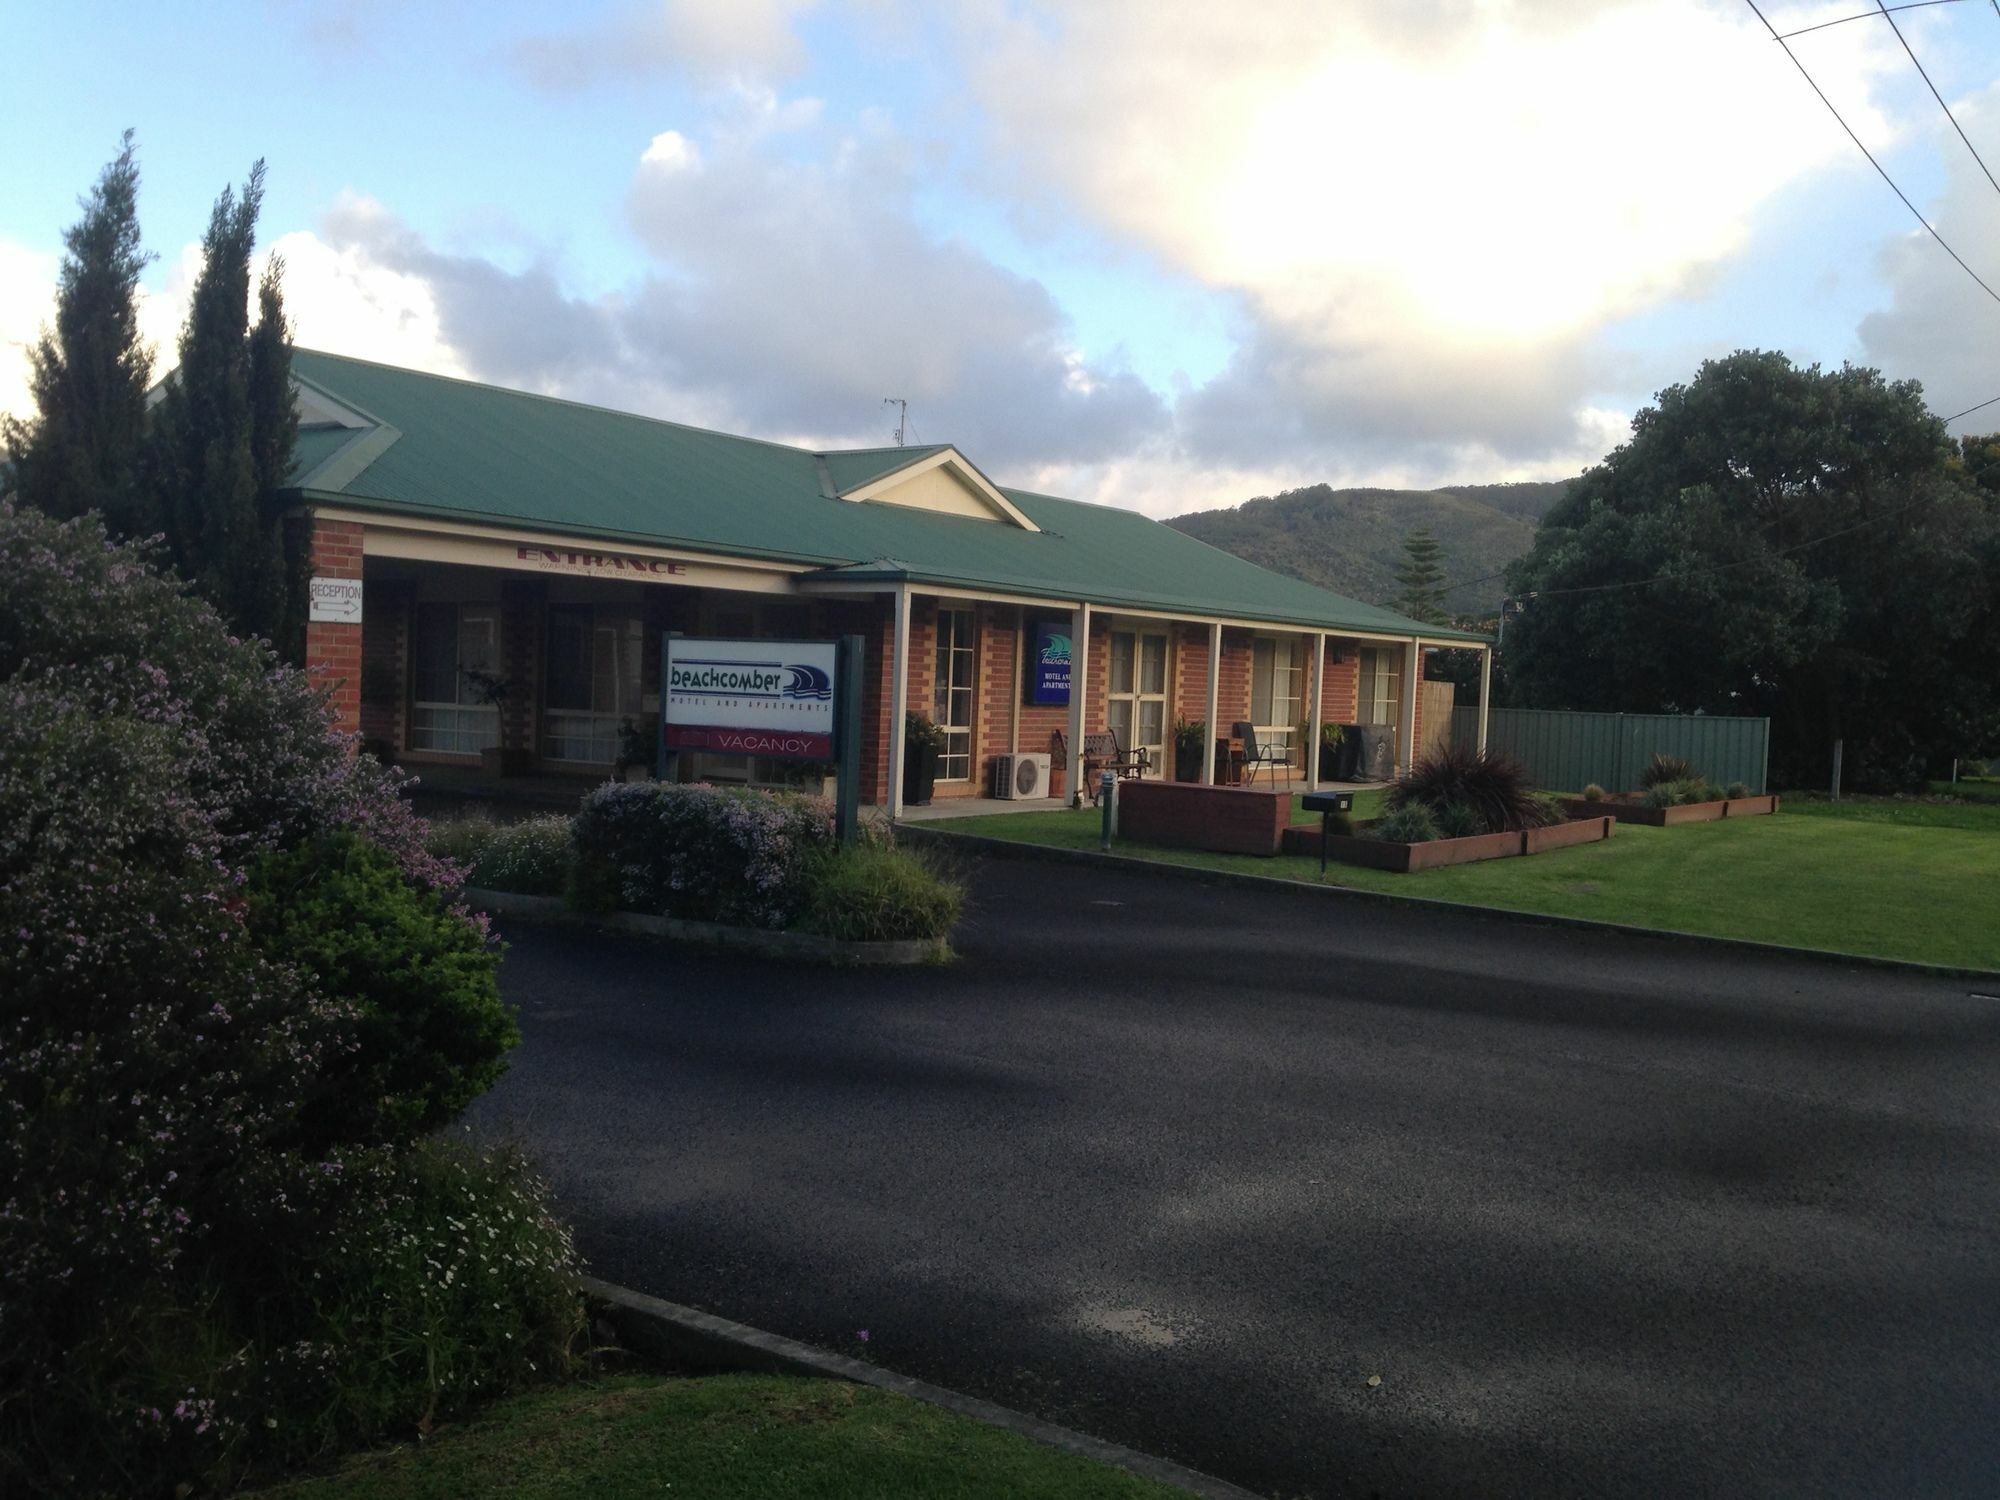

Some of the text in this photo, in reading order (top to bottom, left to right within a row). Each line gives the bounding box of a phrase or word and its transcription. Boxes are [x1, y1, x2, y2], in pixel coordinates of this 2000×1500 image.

[517, 547, 687, 576] ENTRANCE
[311, 583, 361, 600] RECEPTION
[670, 666, 781, 691] beachcomber
[670, 697, 828, 712] MOTEL AND APARTMENTS
[718, 735, 813, 753] VACANCY
